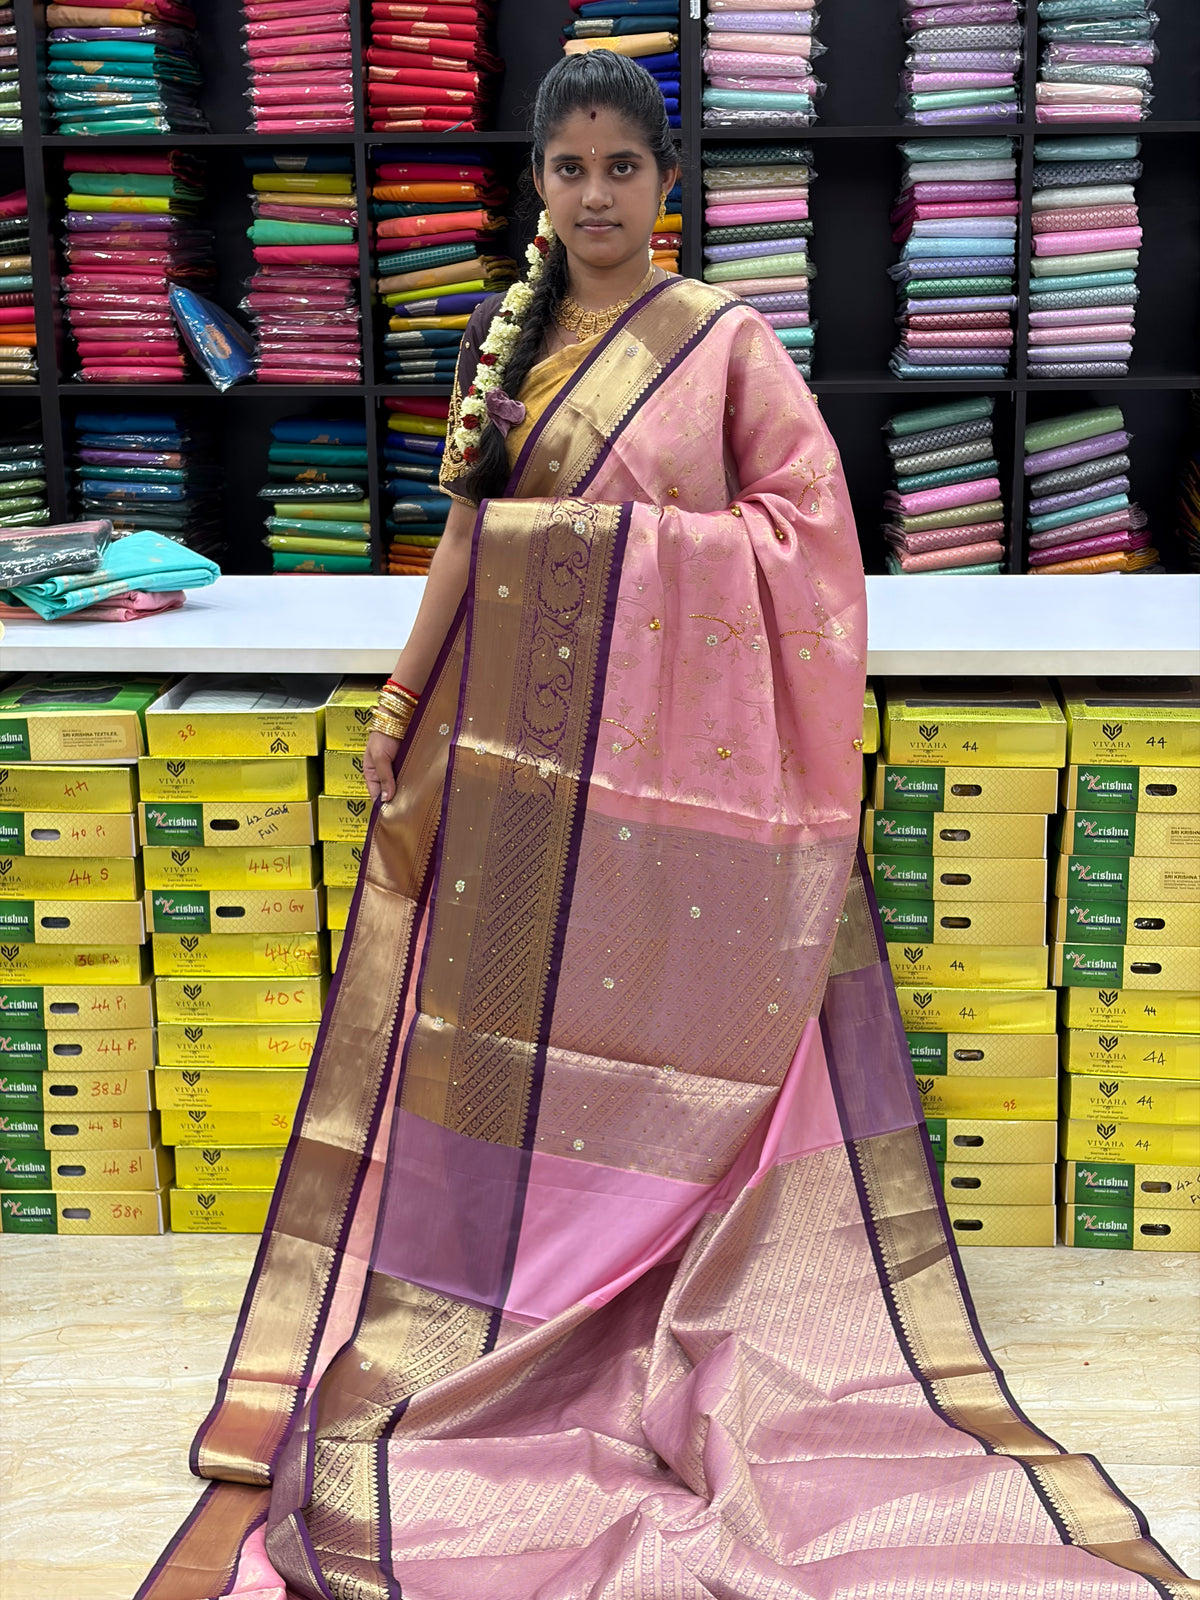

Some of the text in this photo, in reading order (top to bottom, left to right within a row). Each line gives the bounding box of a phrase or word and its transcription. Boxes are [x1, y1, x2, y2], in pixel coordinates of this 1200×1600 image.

[178, 724, 196, 742] 38
[962, 740, 979, 752] 44
[1146, 736, 1168, 749] 44
[894, 775, 938, 790] Krishna
[1088, 776, 1132, 790] Krishna
[154, 812, 198, 827] Krishna
[246, 814, 262, 826] 42
[72, 827, 86, 840] 40
[258, 822, 280, 840] Full
[884, 820, 927, 835] Krishna
[1084, 821, 1129, 836] Krishna
[248, 859, 270, 874] 44
[884, 864, 928, 880] Krishna
[1078, 865, 1122, 880] Krishna
[69, 868, 108, 886] 44 S
[162, 900, 204, 914] Krishna
[261, 900, 282, 915] 40
[884, 908, 928, 924] Krishna
[1076, 908, 1121, 924] Krishna
[264, 944, 288, 964] 44
[1073, 954, 1118, 968] Krishna
[950, 960, 965, 972] 44
[92, 998, 110, 1011] 44
[264, 990, 290, 1006] 40
[958, 1007, 977, 1020] 44
[1144, 1005, 1156, 1016] 44
[0, 1037, 42, 1052] Krishna
[97, 1039, 122, 1056] 44
[268, 1037, 296, 1054] 42
[909, 1045, 942, 1056] rishna
[1142, 1050, 1166, 1066] 44
[91, 1082, 109, 1097] 38
[1090, 1098, 1128, 1106] VIVAHA
[1136, 1096, 1154, 1110] 44
[88, 1120, 104, 1132] 44
[272, 1114, 288, 1130] 36
[1135, 1140, 1151, 1152] 44
[5, 1158, 46, 1173] Krishna
[102, 1160, 120, 1176] 44
[1085, 1172, 1128, 1187] Krishna
[1176, 1180, 1192, 1191] 42
[10, 1201, 52, 1216] Krishna
[1084, 1216, 1128, 1230] Krishna
